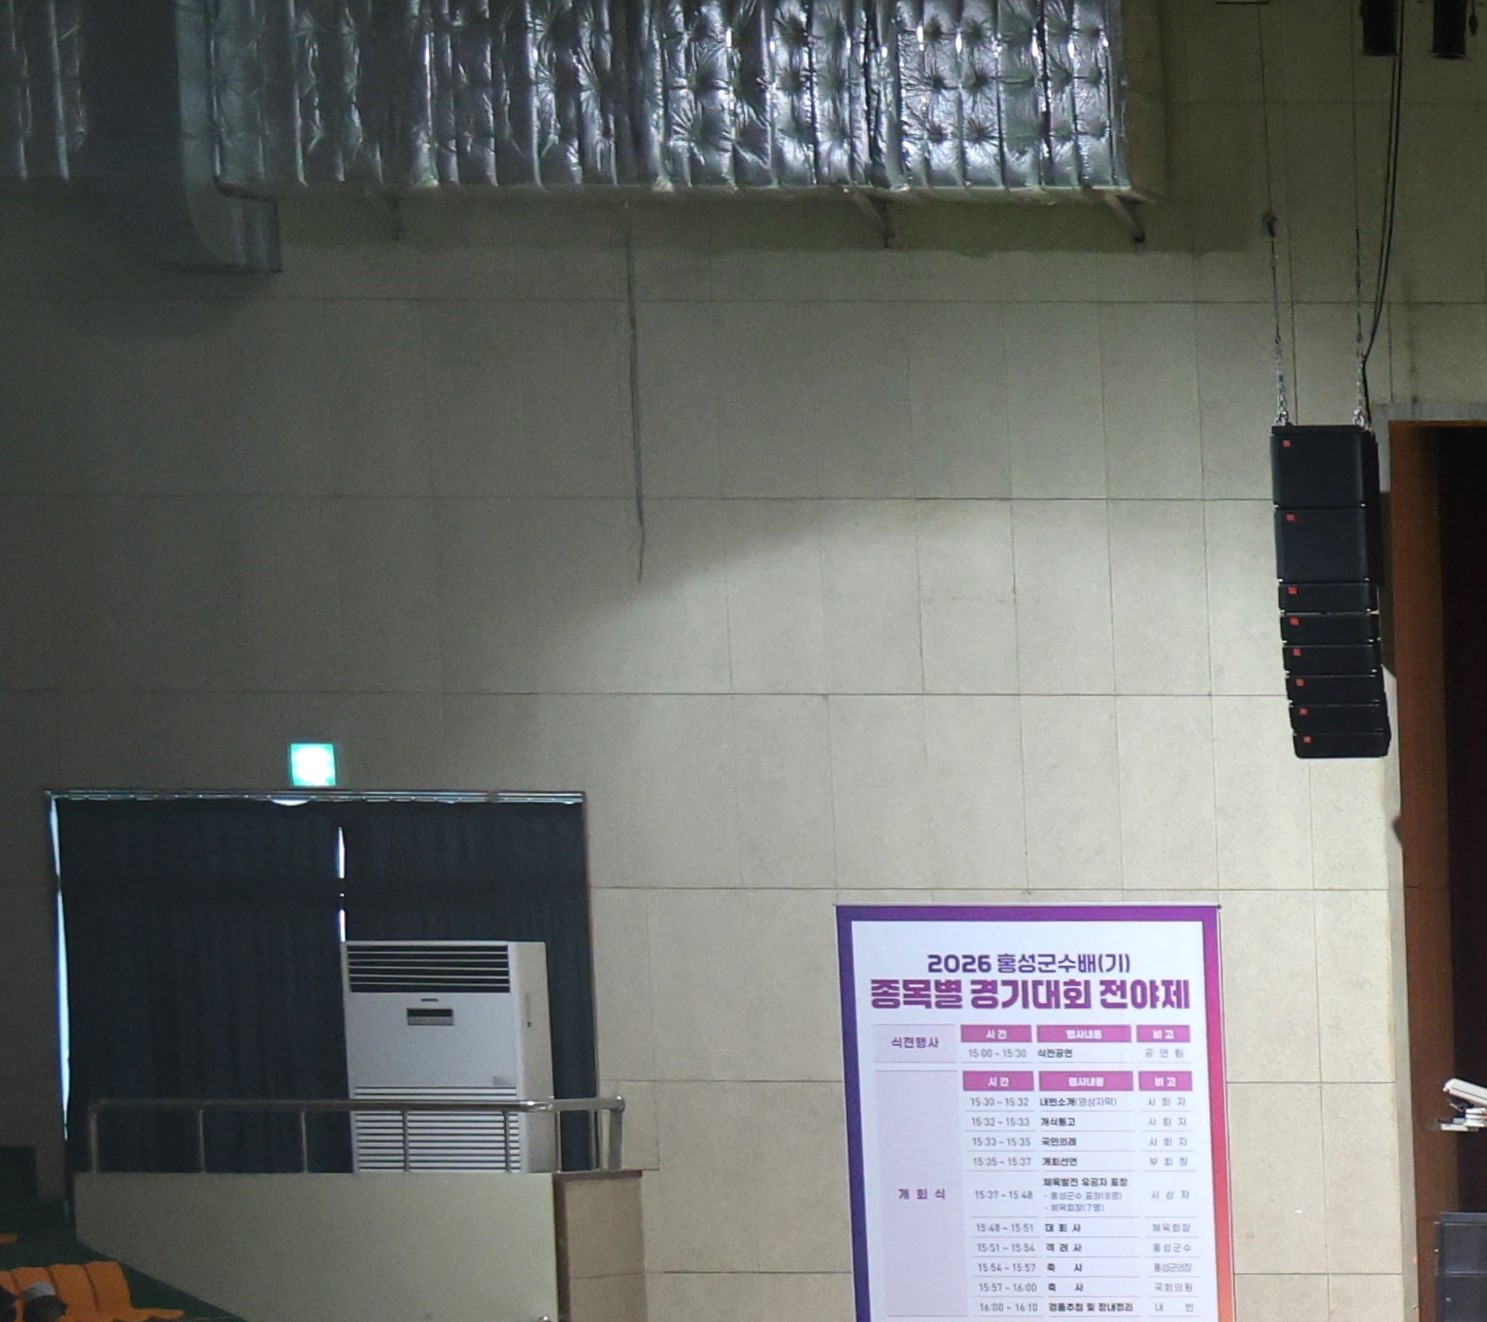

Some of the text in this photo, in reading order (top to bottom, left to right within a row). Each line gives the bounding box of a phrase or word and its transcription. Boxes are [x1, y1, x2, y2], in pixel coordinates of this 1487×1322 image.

[927, 953, 1131, 974] 2026 홍성군수배(기)
[871, 978, 1191, 1010] 종목별 경기대회 전야제
[891, 1036, 939, 1048] 식전행사
